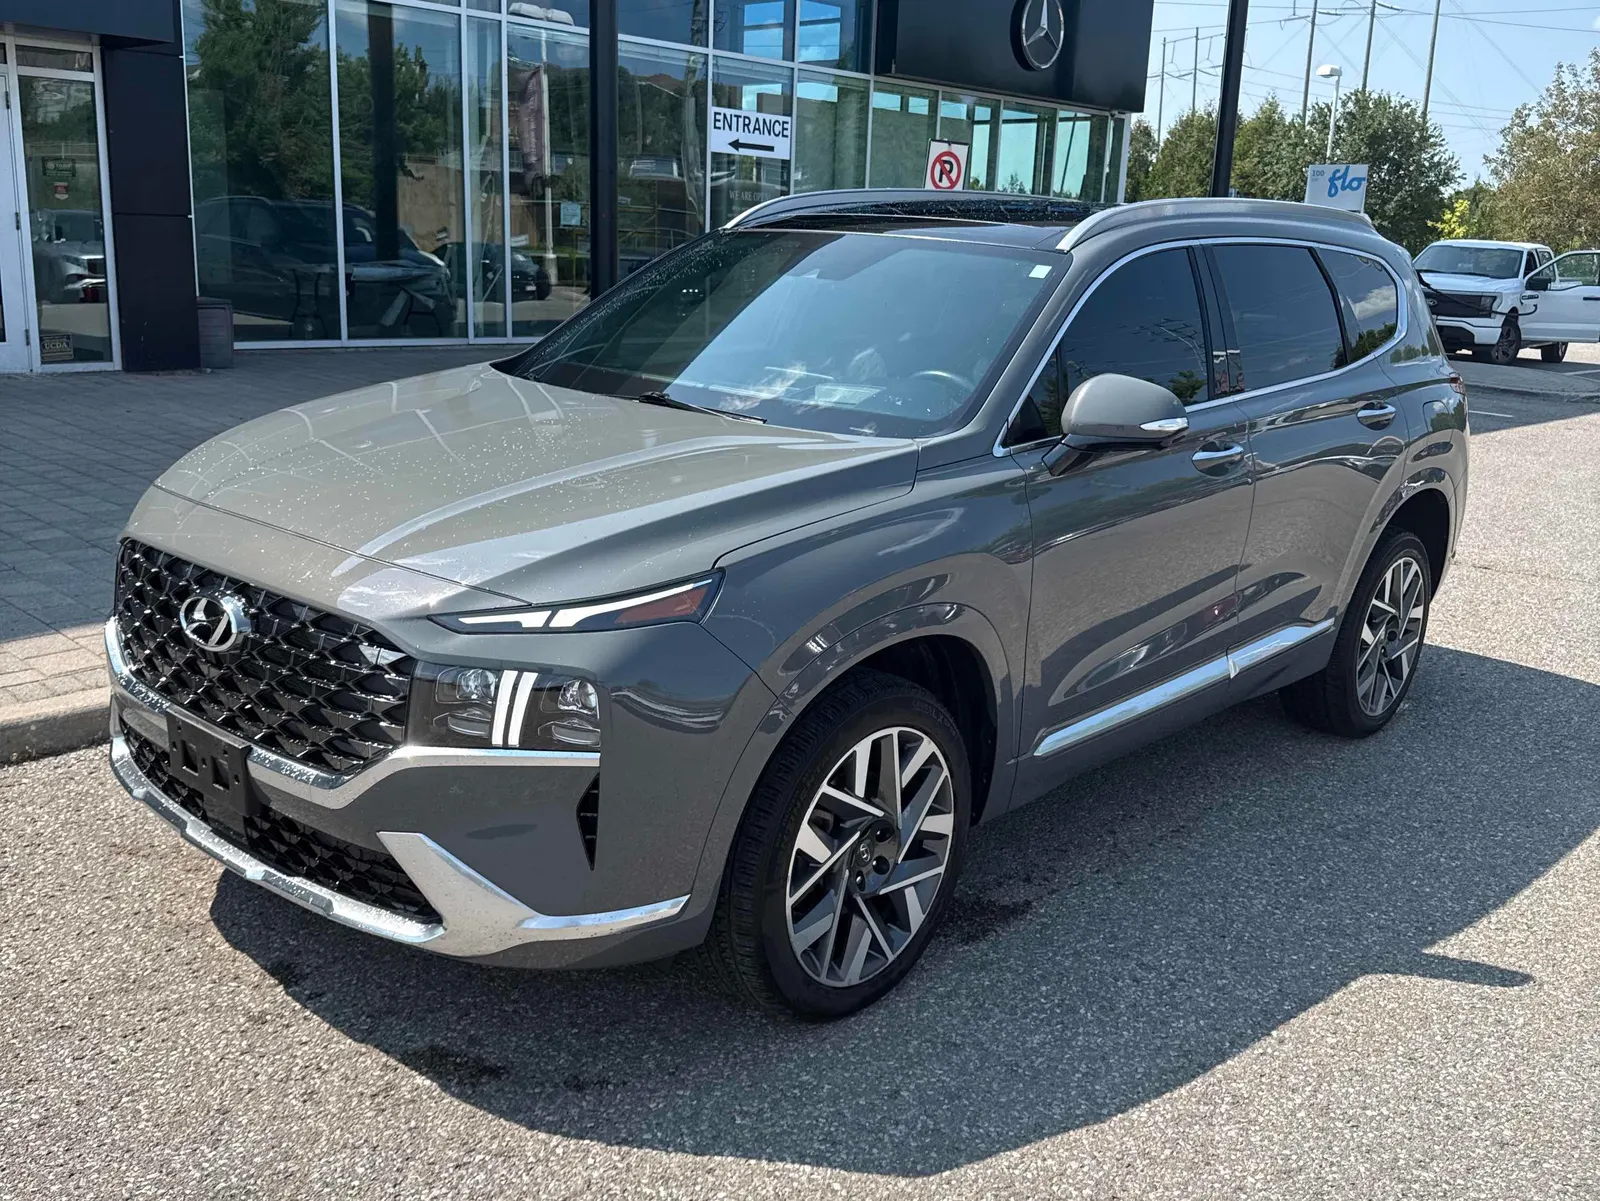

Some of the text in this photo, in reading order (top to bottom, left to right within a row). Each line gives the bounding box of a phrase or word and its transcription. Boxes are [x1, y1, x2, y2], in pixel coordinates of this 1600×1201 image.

[713, 111, 790, 138] ENTRANCE
[1328, 165, 1366, 197] flo
[729, 190, 740, 201] WE
[741, 191, 753, 201] ARE
[44, 341, 68, 349] UCDA
